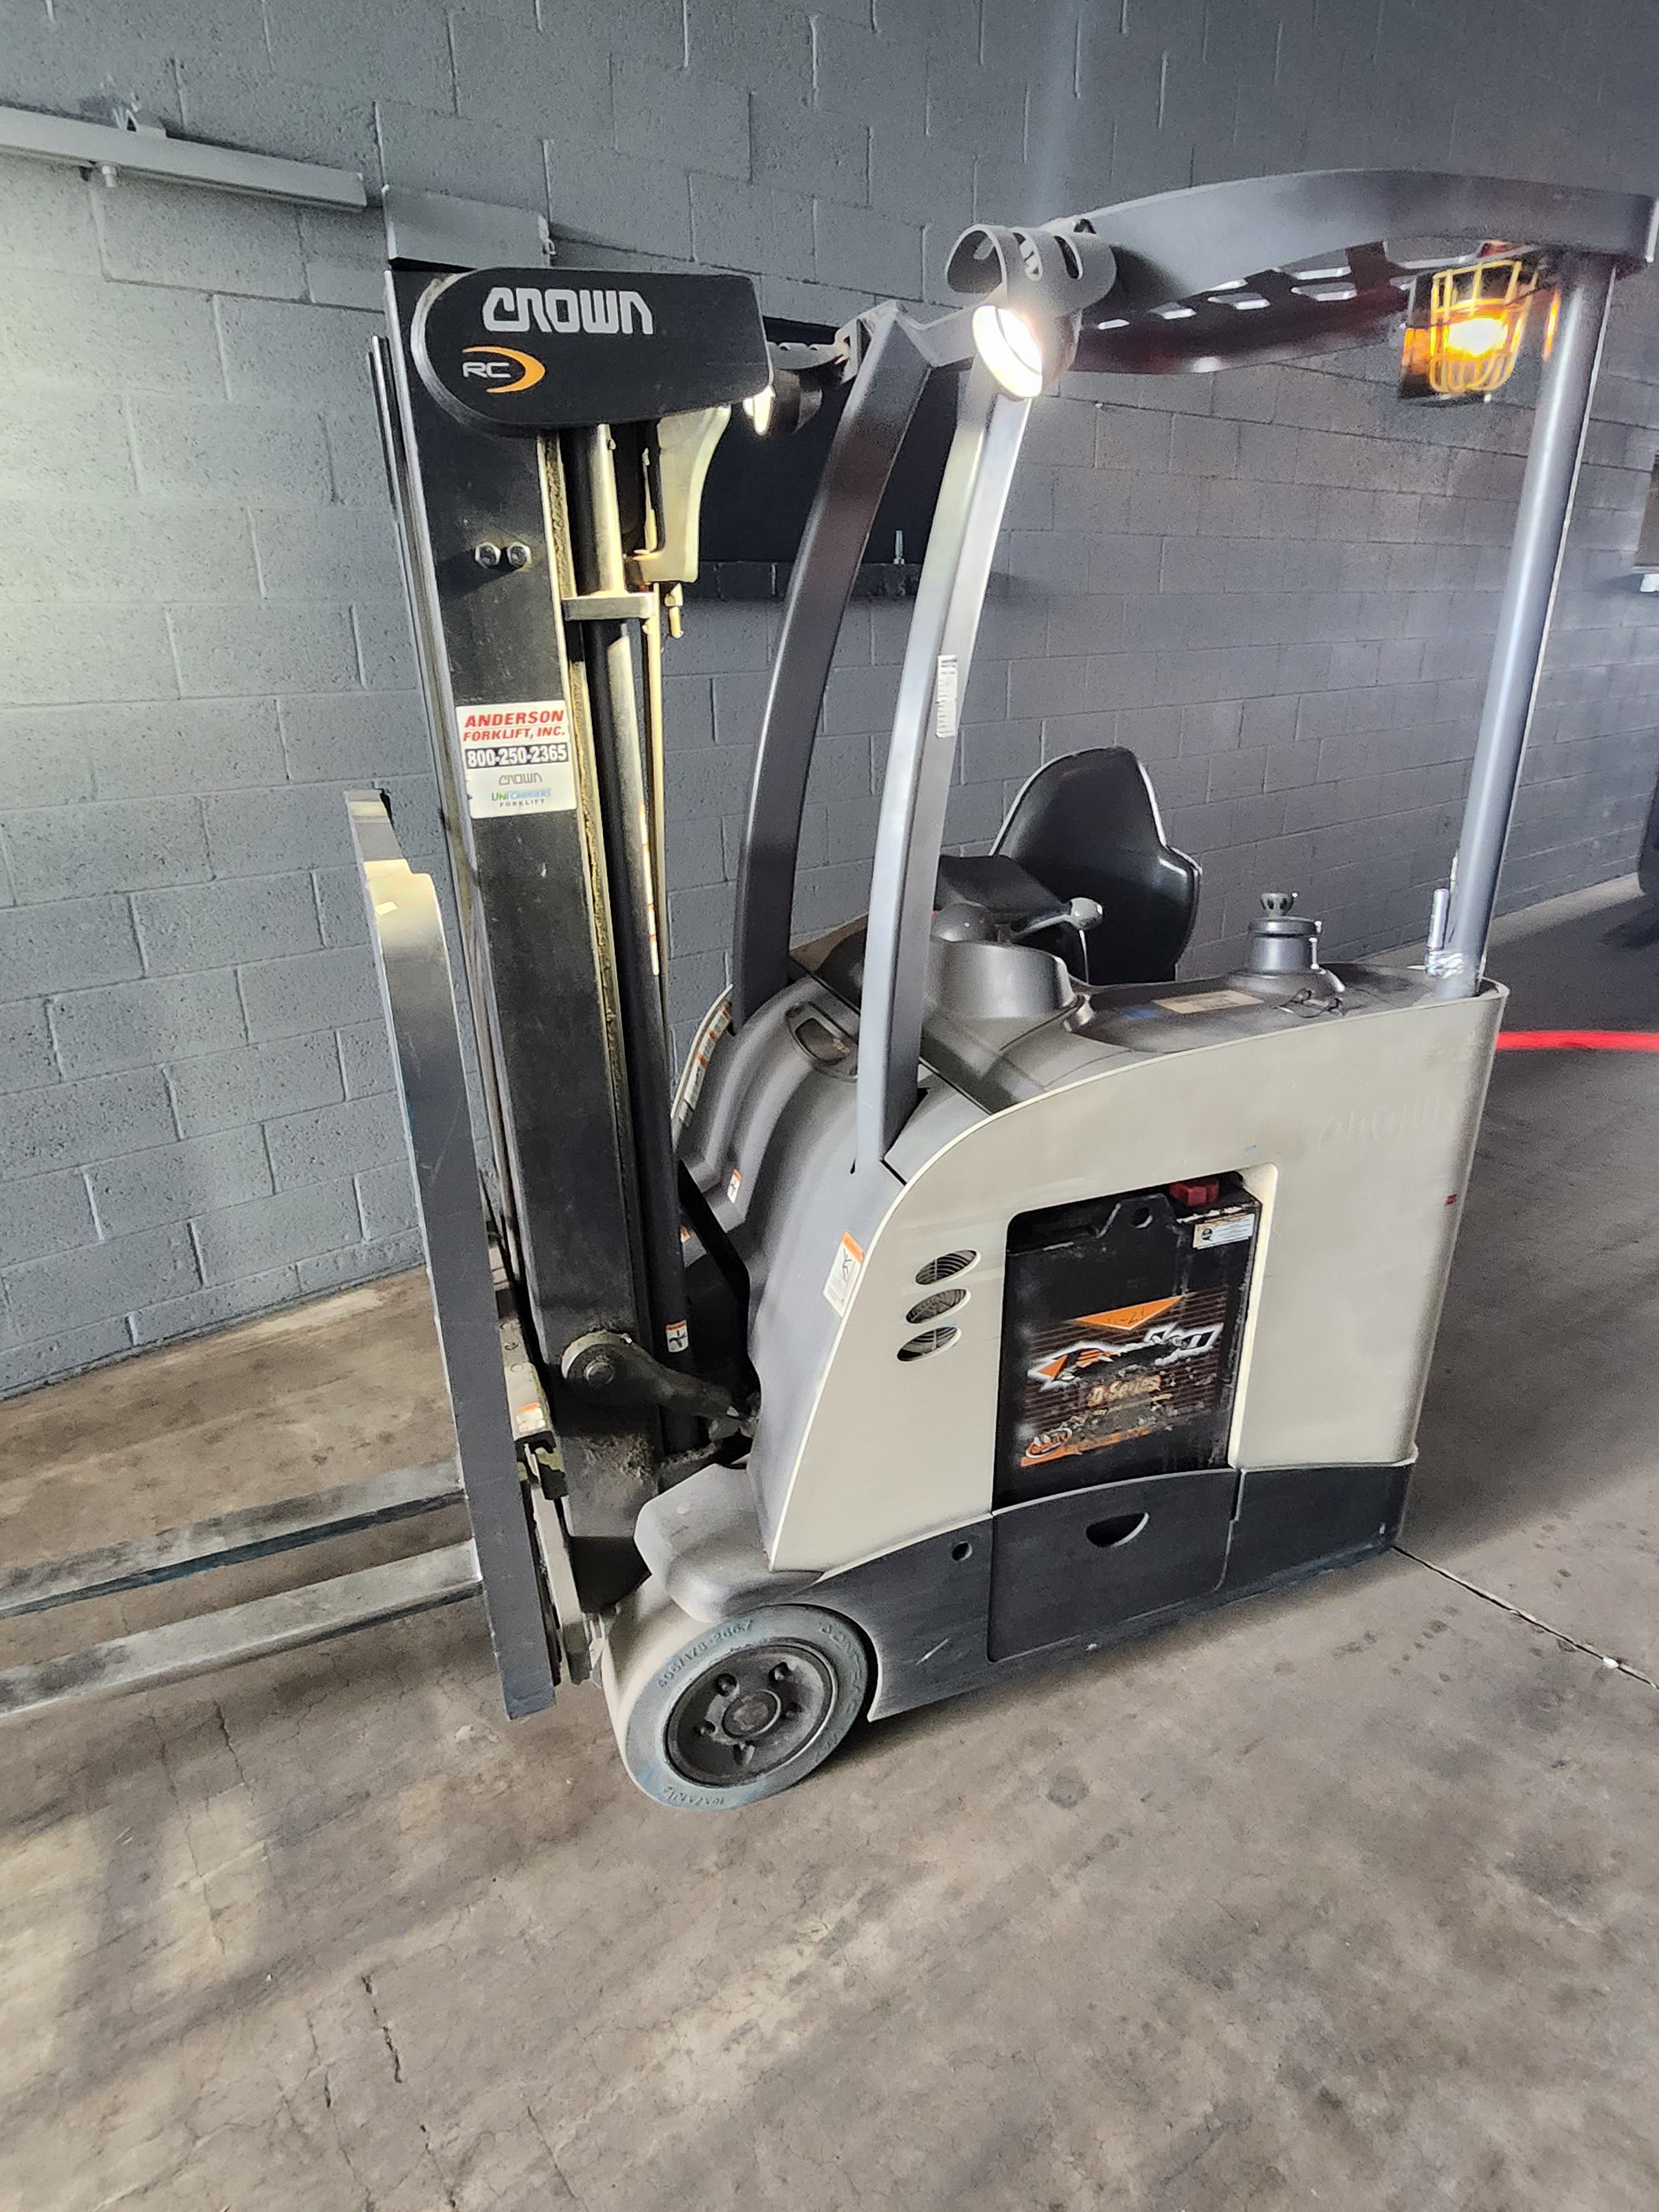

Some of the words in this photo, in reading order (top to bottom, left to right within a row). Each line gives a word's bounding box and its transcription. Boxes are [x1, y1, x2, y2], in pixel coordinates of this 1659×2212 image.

[482, 287, 654, 335] CROWN
[462, 362, 512, 379] RC
[465, 710, 564, 727] ANDERSON
[462, 727, 534, 742] FORKLIFT,
[536, 726, 566, 737] INC.
[466, 744, 567, 768] 800-250-2365
[498, 772, 543, 786] CROWN
[499, 799, 545, 807] FORKLIFT
